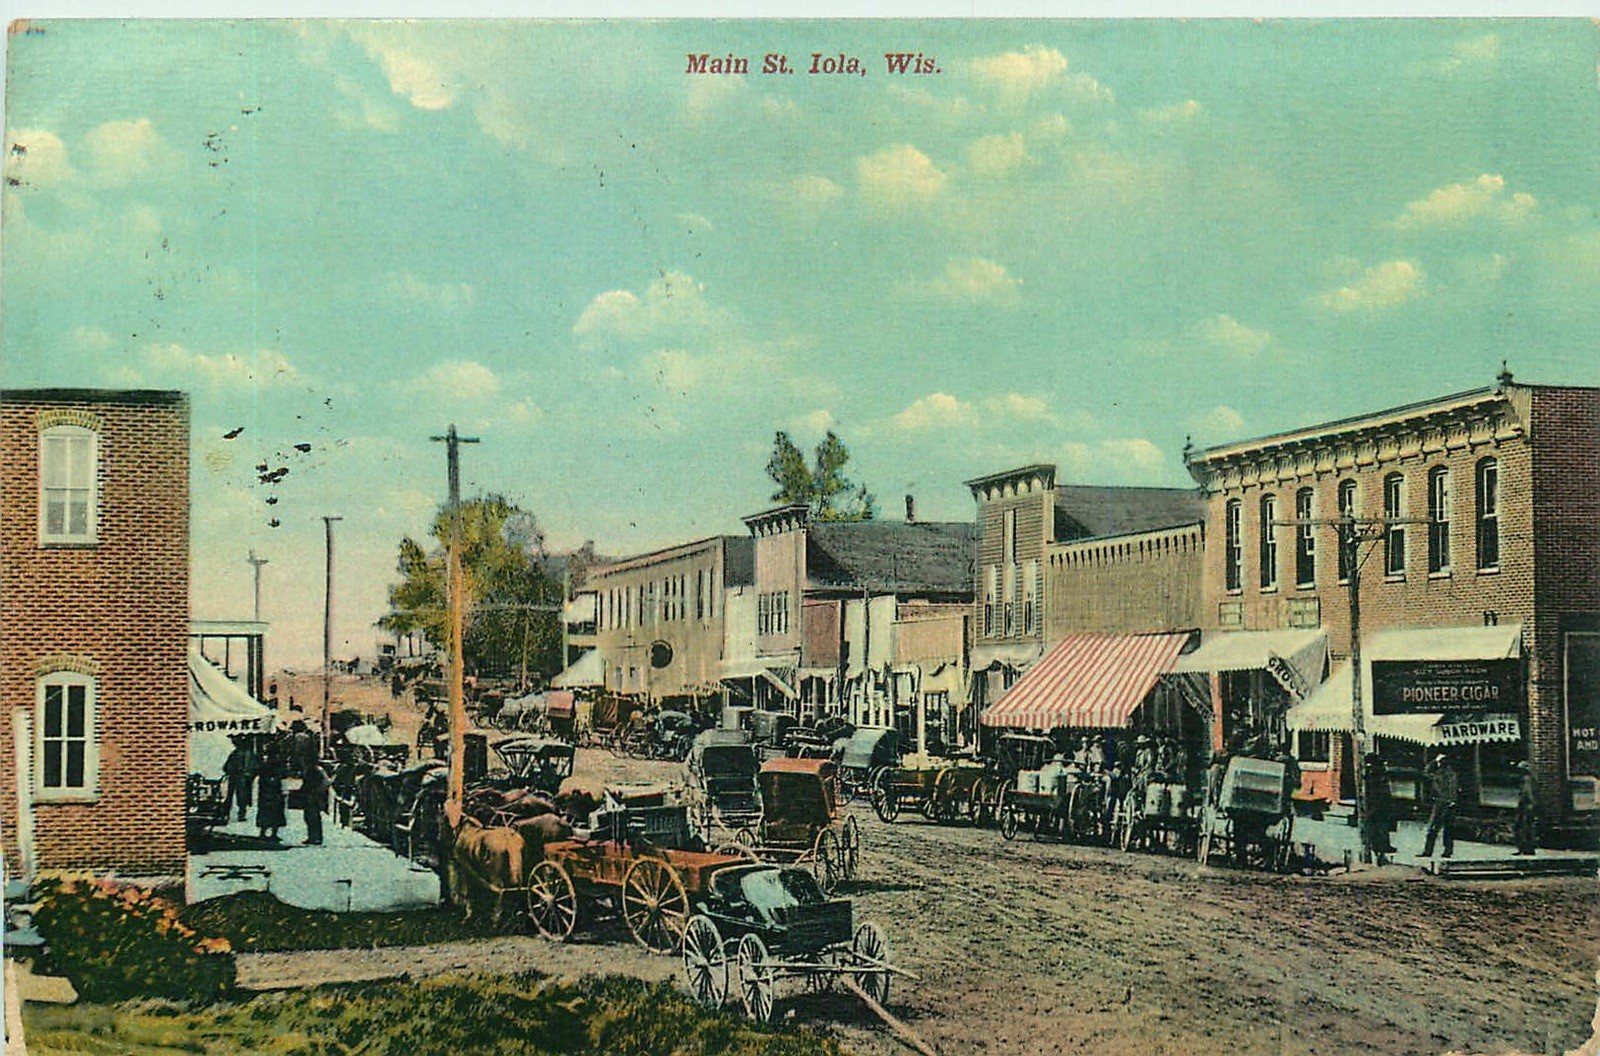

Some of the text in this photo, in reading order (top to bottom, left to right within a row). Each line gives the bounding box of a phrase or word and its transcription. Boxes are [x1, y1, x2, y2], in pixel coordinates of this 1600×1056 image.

[1403, 685, 1500, 702] PIONEER CIGAR
[1441, 721, 1517, 739] HARDWARE
[1571, 728, 1596, 738] HOT
